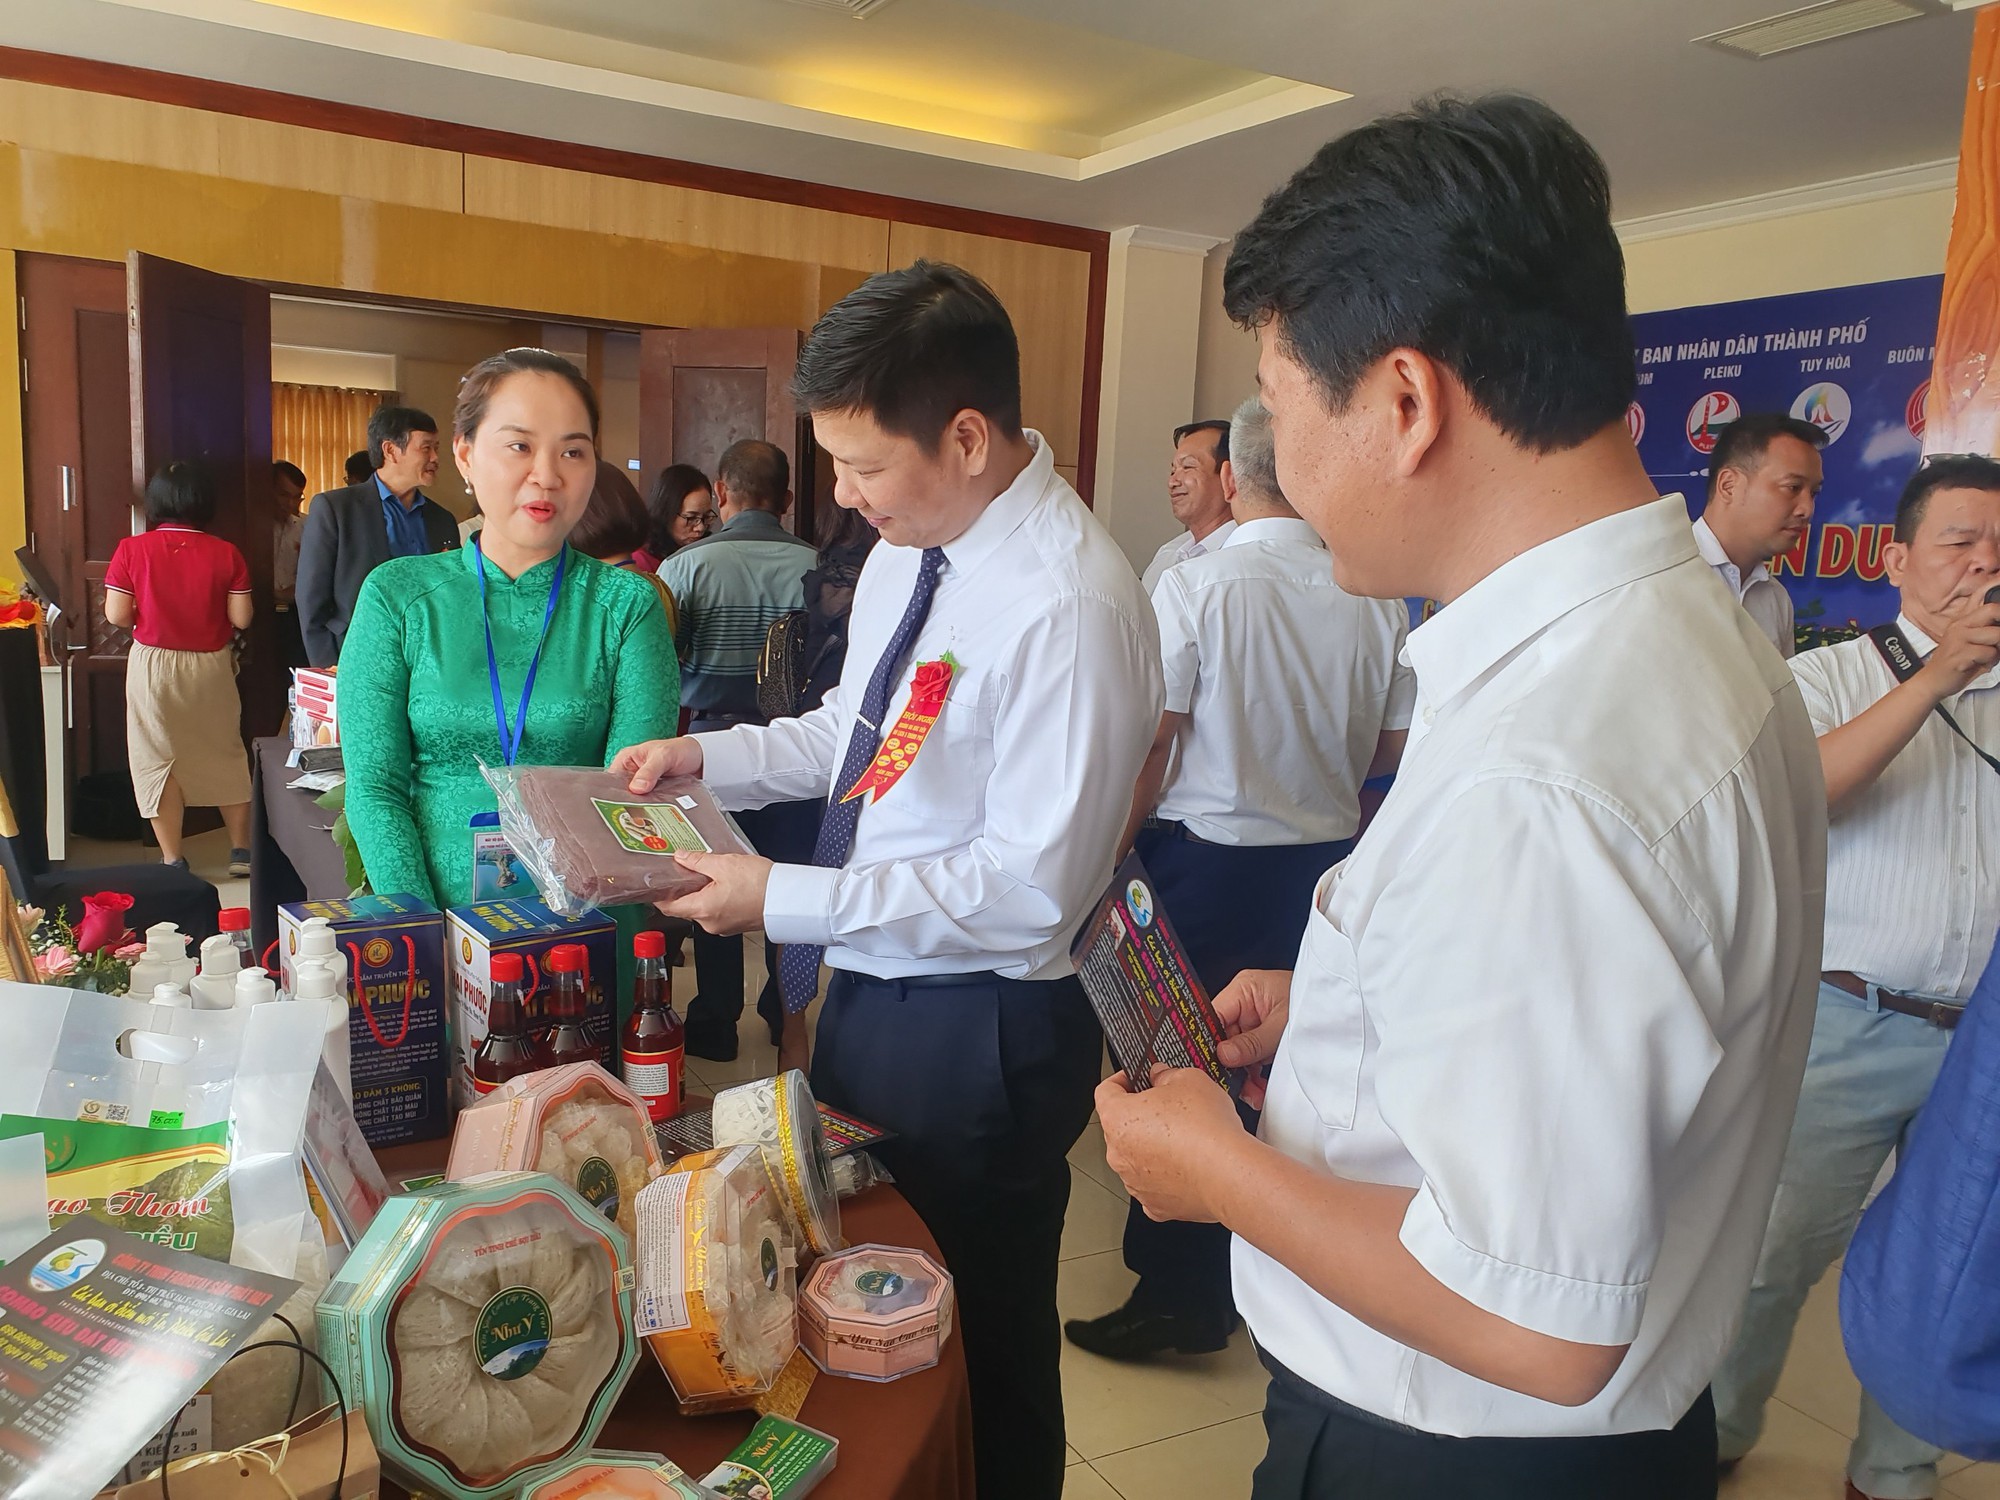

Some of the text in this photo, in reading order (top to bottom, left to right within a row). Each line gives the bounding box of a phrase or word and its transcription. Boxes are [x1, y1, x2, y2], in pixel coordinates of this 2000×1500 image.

[1642, 346, 1672, 364] BAN
[1677, 338, 1720, 361] NHÂN
[1724, 334, 1758, 356] DÂN
[1764, 326, 1822, 351] THÀNH
[1827, 316, 1870, 345] PHỐ
[1800, 353, 1851, 373] TUY HÒA
[1888, 345, 1924, 364] BUÔN
[1704, 365, 1742, 379] PLEIKU
[1885, 636, 1912, 670] Canon
[374, 969, 397, 980] TRUYỀN
[1146, 935, 1156, 951] Các
[1152, 951, 1164, 968] bạn
[1179, 1000, 1190, 1017] mới
[1195, 1032, 1212, 1061] Pleiku
[1210, 1061, 1219, 1077] Gia
[373, 1098, 388, 1108] CHẤT
[373, 1106, 389, 1116] CHẤT
[373, 1115, 389, 1125] CHẤT
[106, 1190, 212, 1218] Thơm
[71, 1284, 89, 1303] Các
[87, 1291, 106, 1312] bạn
[491, 1323, 522, 1343] Như
[173, 1445, 179, 1453] 2
[191, 1443, 197, 1451] 3
